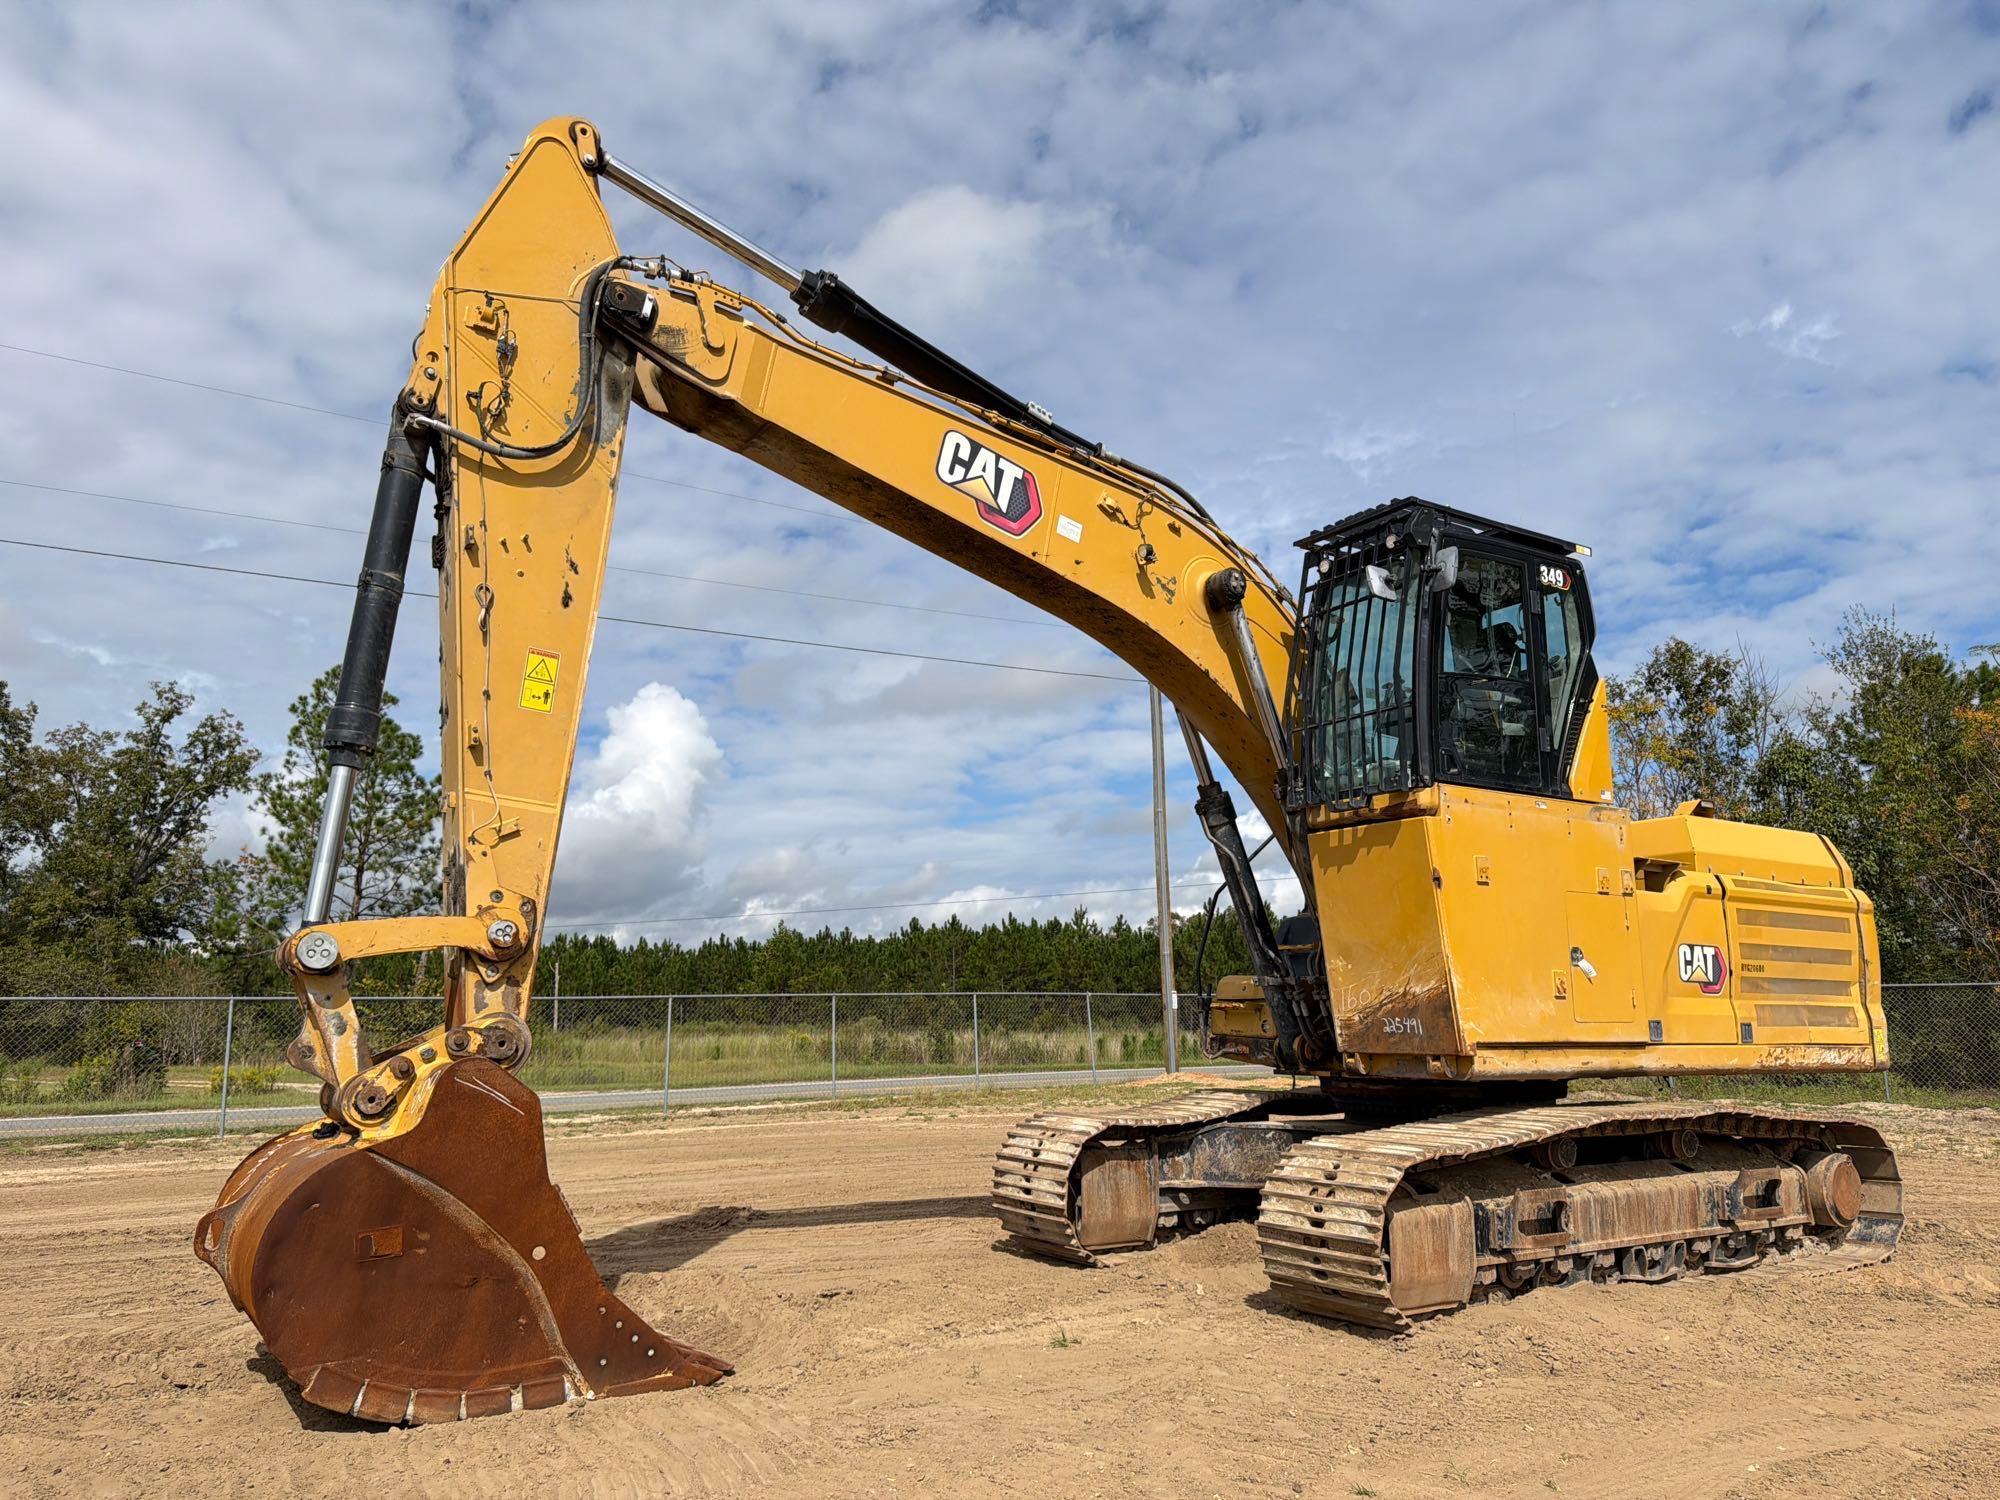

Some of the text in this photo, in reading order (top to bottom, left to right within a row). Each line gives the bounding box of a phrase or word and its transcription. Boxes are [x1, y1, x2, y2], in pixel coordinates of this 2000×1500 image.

[938, 431, 1024, 513] CAT
[1540, 565, 1564, 587] 349
[1678, 944, 1715, 983] CAT
[1382, 1017, 1423, 1035] 225491
